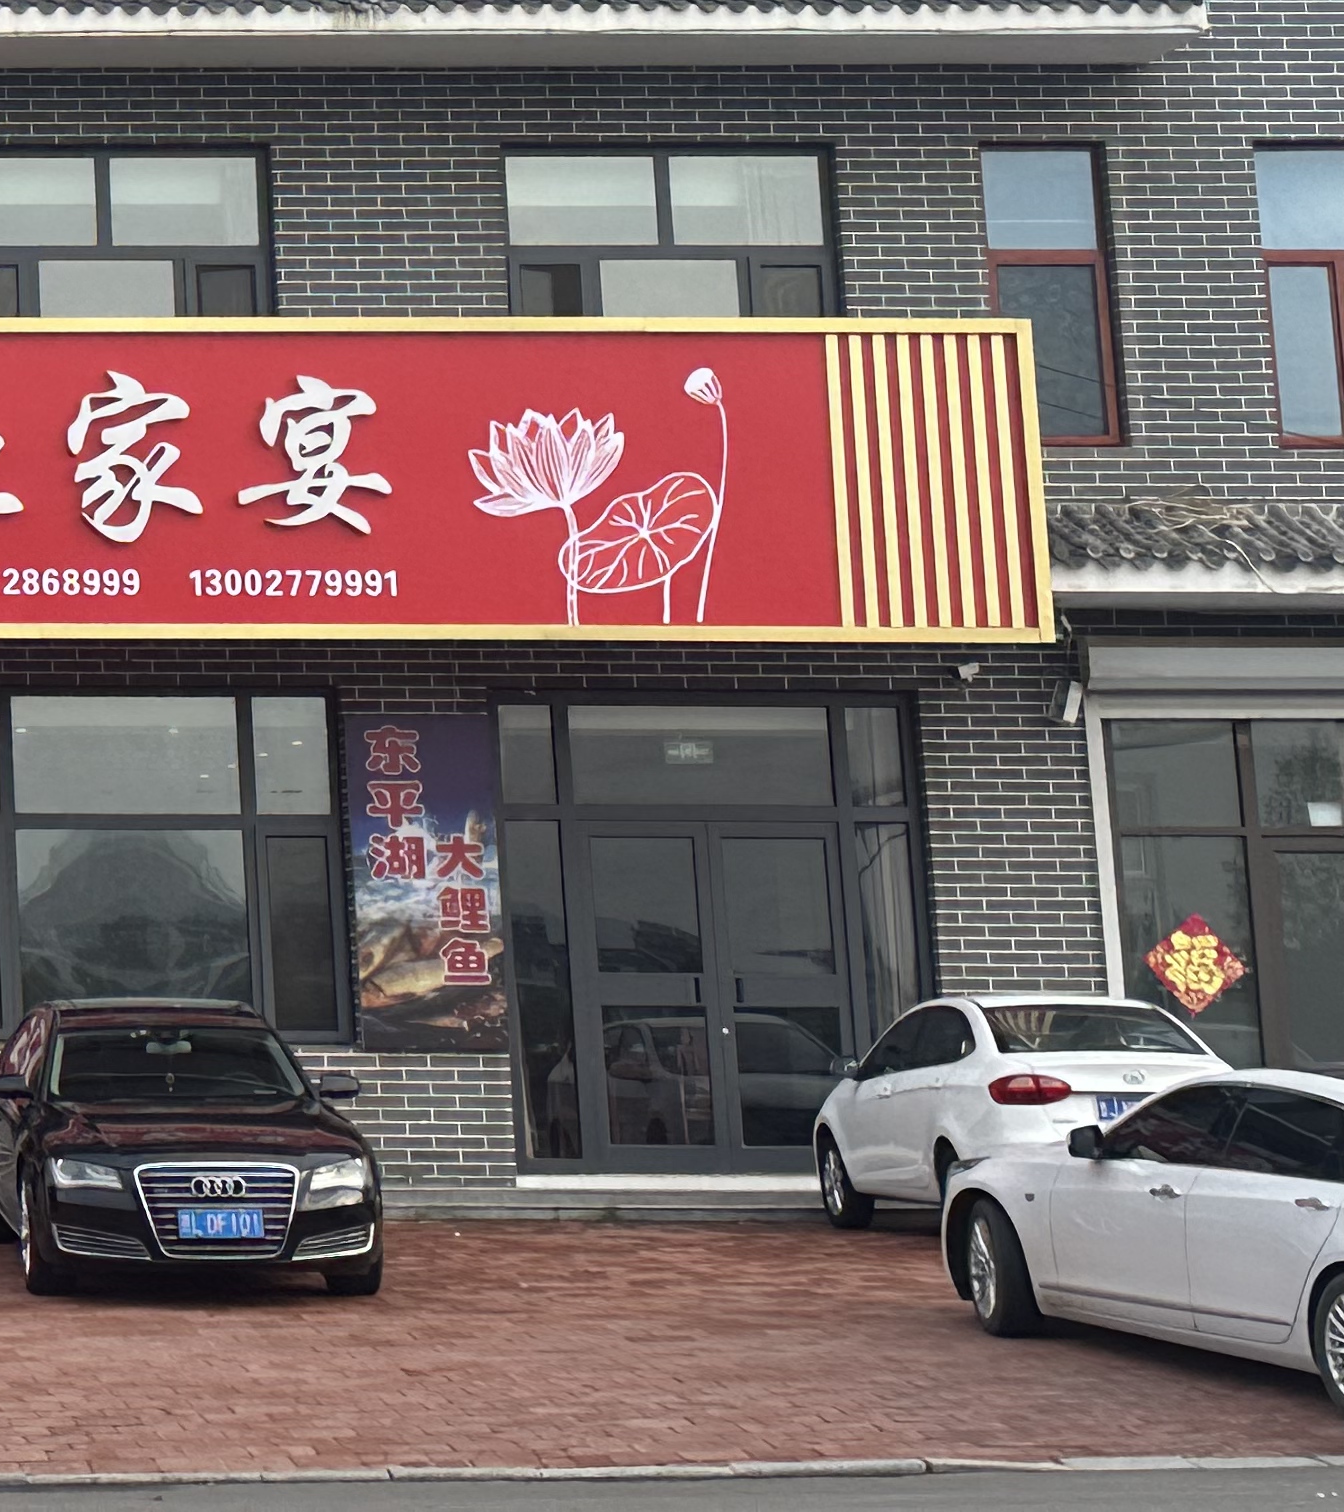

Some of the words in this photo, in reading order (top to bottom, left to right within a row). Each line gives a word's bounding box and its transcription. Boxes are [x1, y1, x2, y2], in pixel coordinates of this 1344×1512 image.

[188, 568, 400, 598] 13002779991
[363, 724, 426, 881] 东平湖
[435, 834, 492, 986] 大鲤鱼
